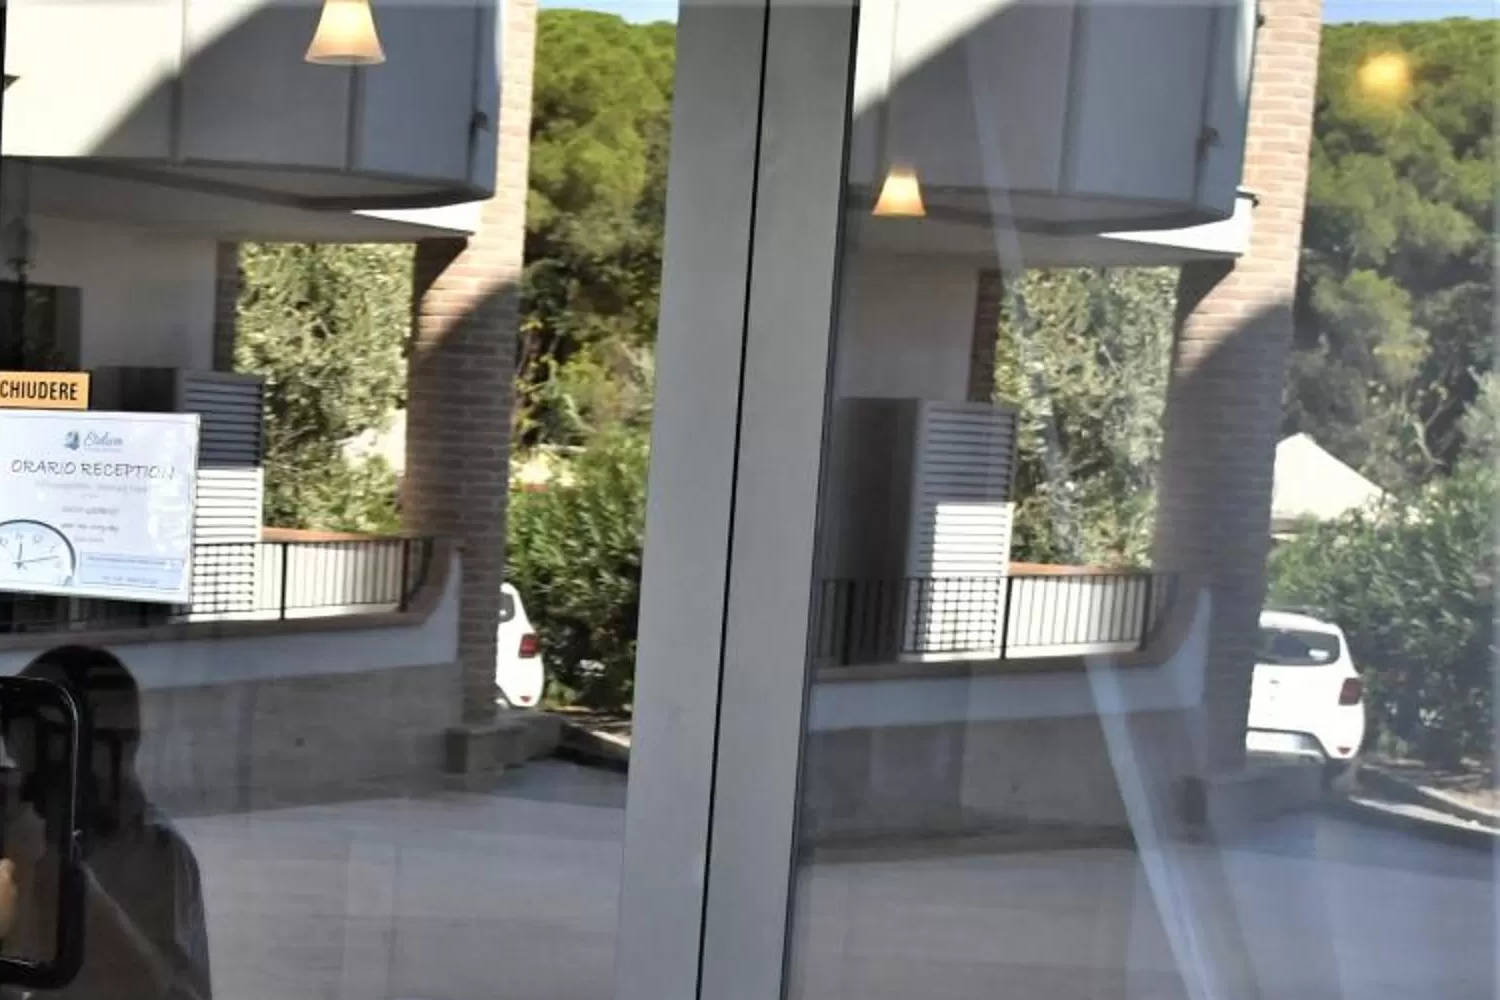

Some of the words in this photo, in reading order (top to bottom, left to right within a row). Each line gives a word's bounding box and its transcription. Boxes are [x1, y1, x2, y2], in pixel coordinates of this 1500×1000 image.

[0, 380, 78, 401] CHIUDERE
[11, 459, 76, 476] ORARIO
[80, 463, 176, 481] RECEPTION
